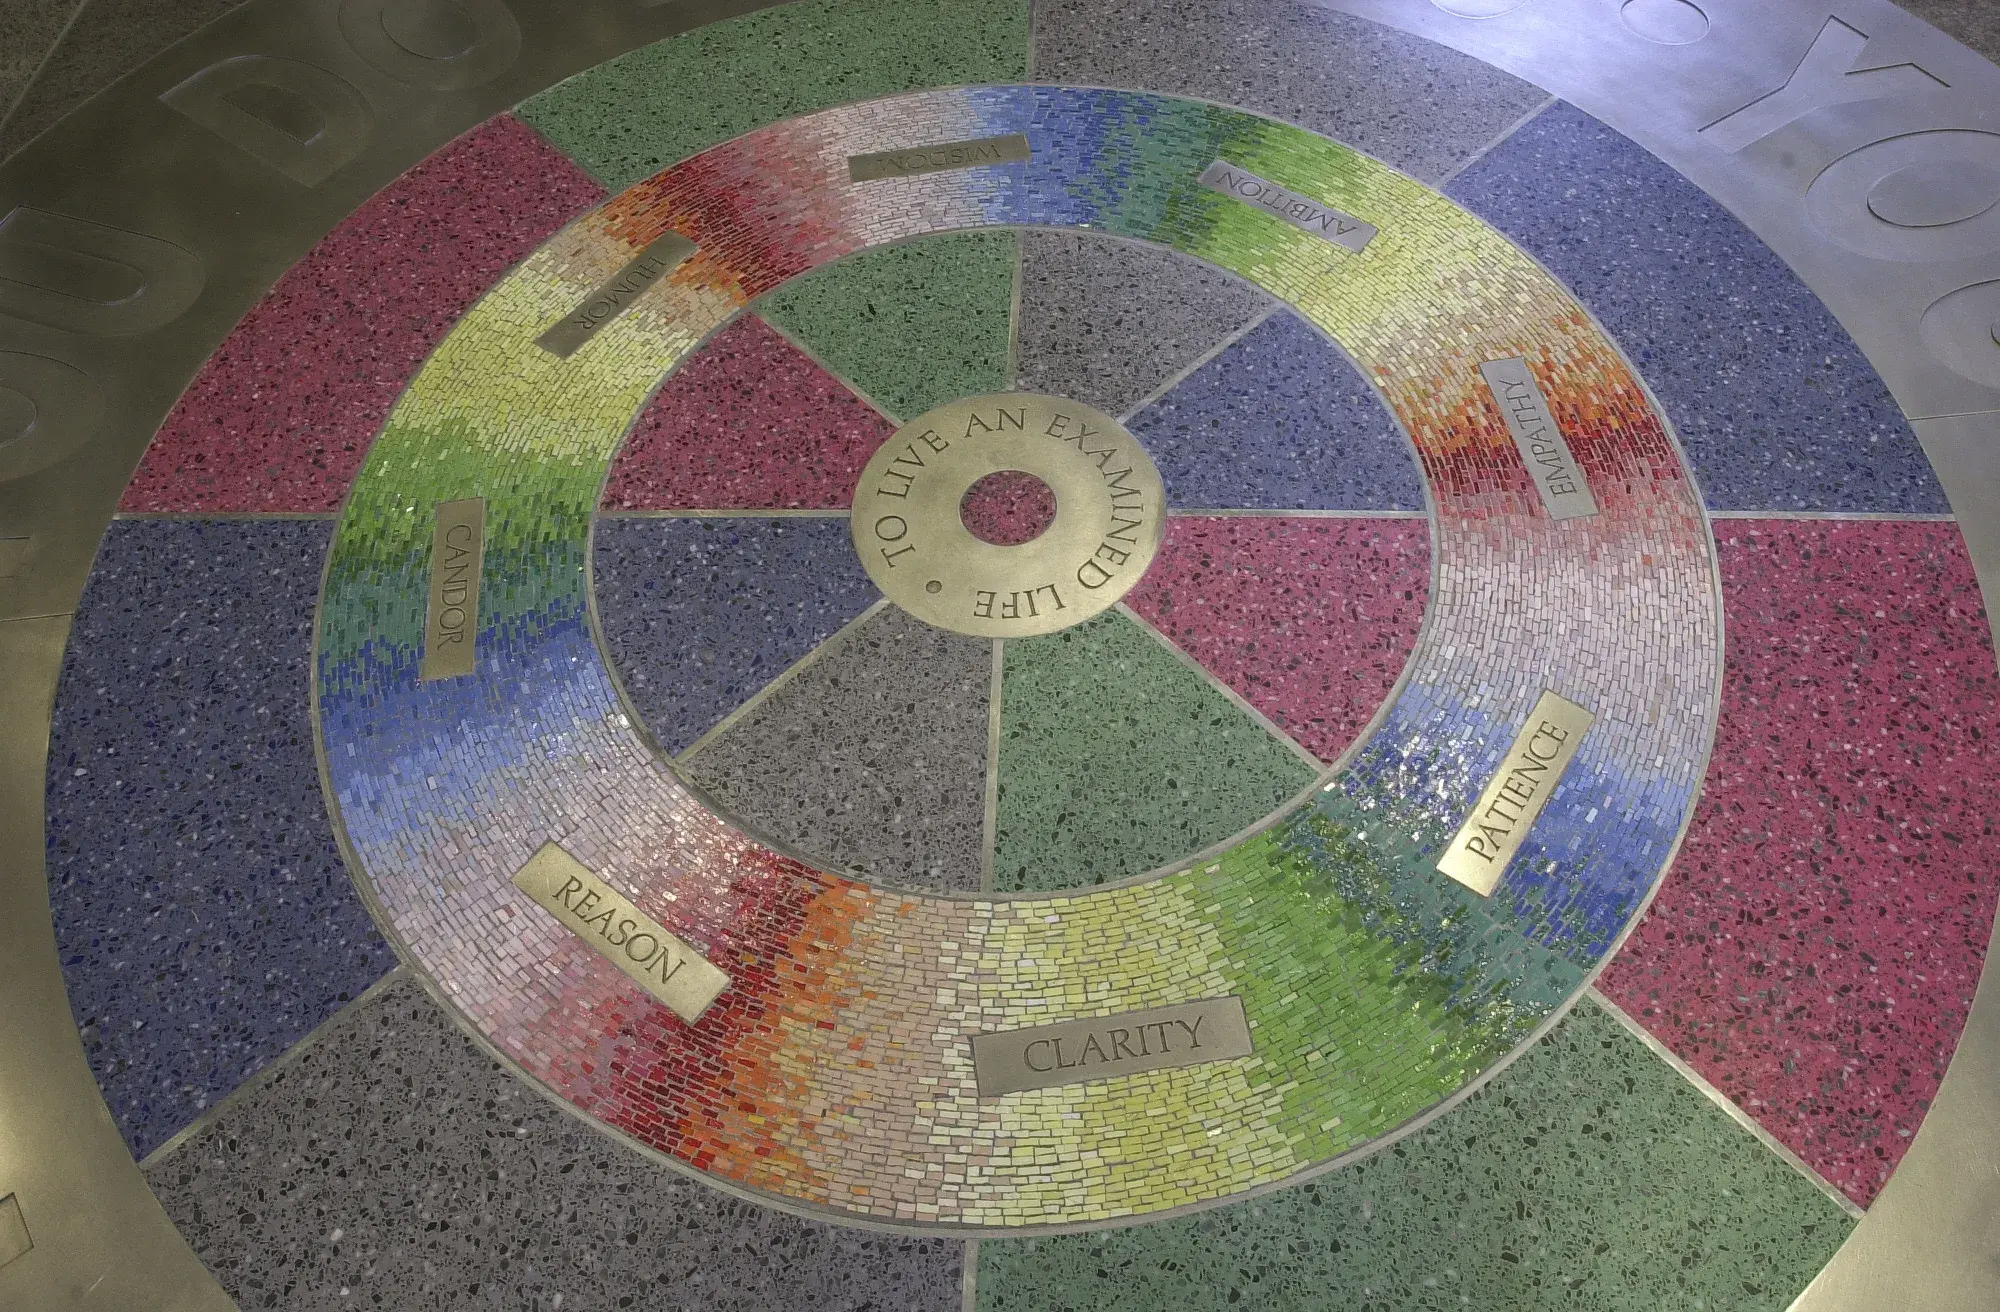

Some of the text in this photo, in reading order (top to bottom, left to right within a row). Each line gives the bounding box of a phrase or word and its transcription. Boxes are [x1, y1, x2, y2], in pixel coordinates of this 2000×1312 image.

[877, 144, 1001, 171] WISDOM
[1215, 171, 1357, 236] AMBITION
[573, 256, 667, 330] HUMOR
[1498, 379, 1578, 498] EMPATHY
[875, 408, 1144, 619] TO LIVE AN EXAMINED LIFE
[437, 524, 472, 650] CANDOR
[1465, 720, 1569, 865] PATIENCE
[551, 875, 687, 984] REASON
[1023, 1015, 1203, 1072] CLARITY
